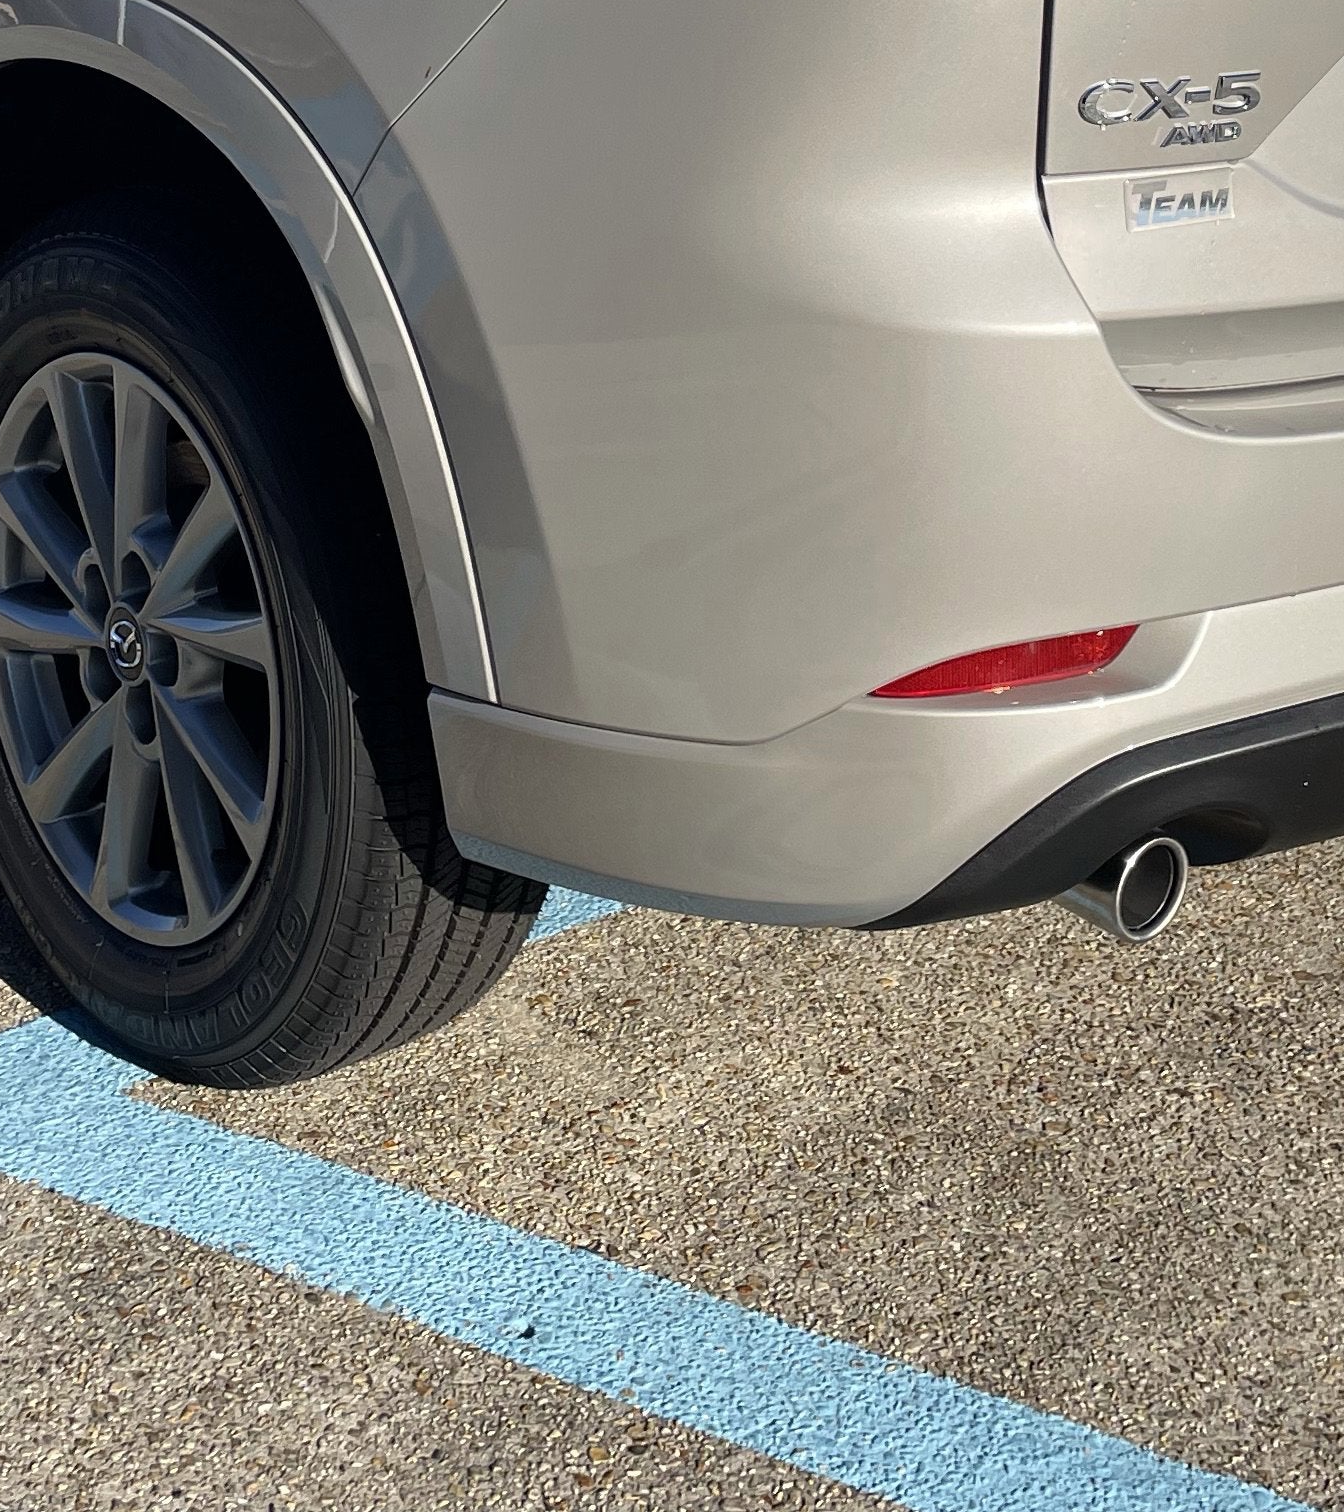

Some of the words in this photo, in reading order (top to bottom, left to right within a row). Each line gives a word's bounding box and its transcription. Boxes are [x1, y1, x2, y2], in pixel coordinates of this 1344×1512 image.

[1077, 69, 1262, 126] CX-5
[1159, 119, 1243, 148] AWD
[1131, 179, 1230, 226] TEAM
